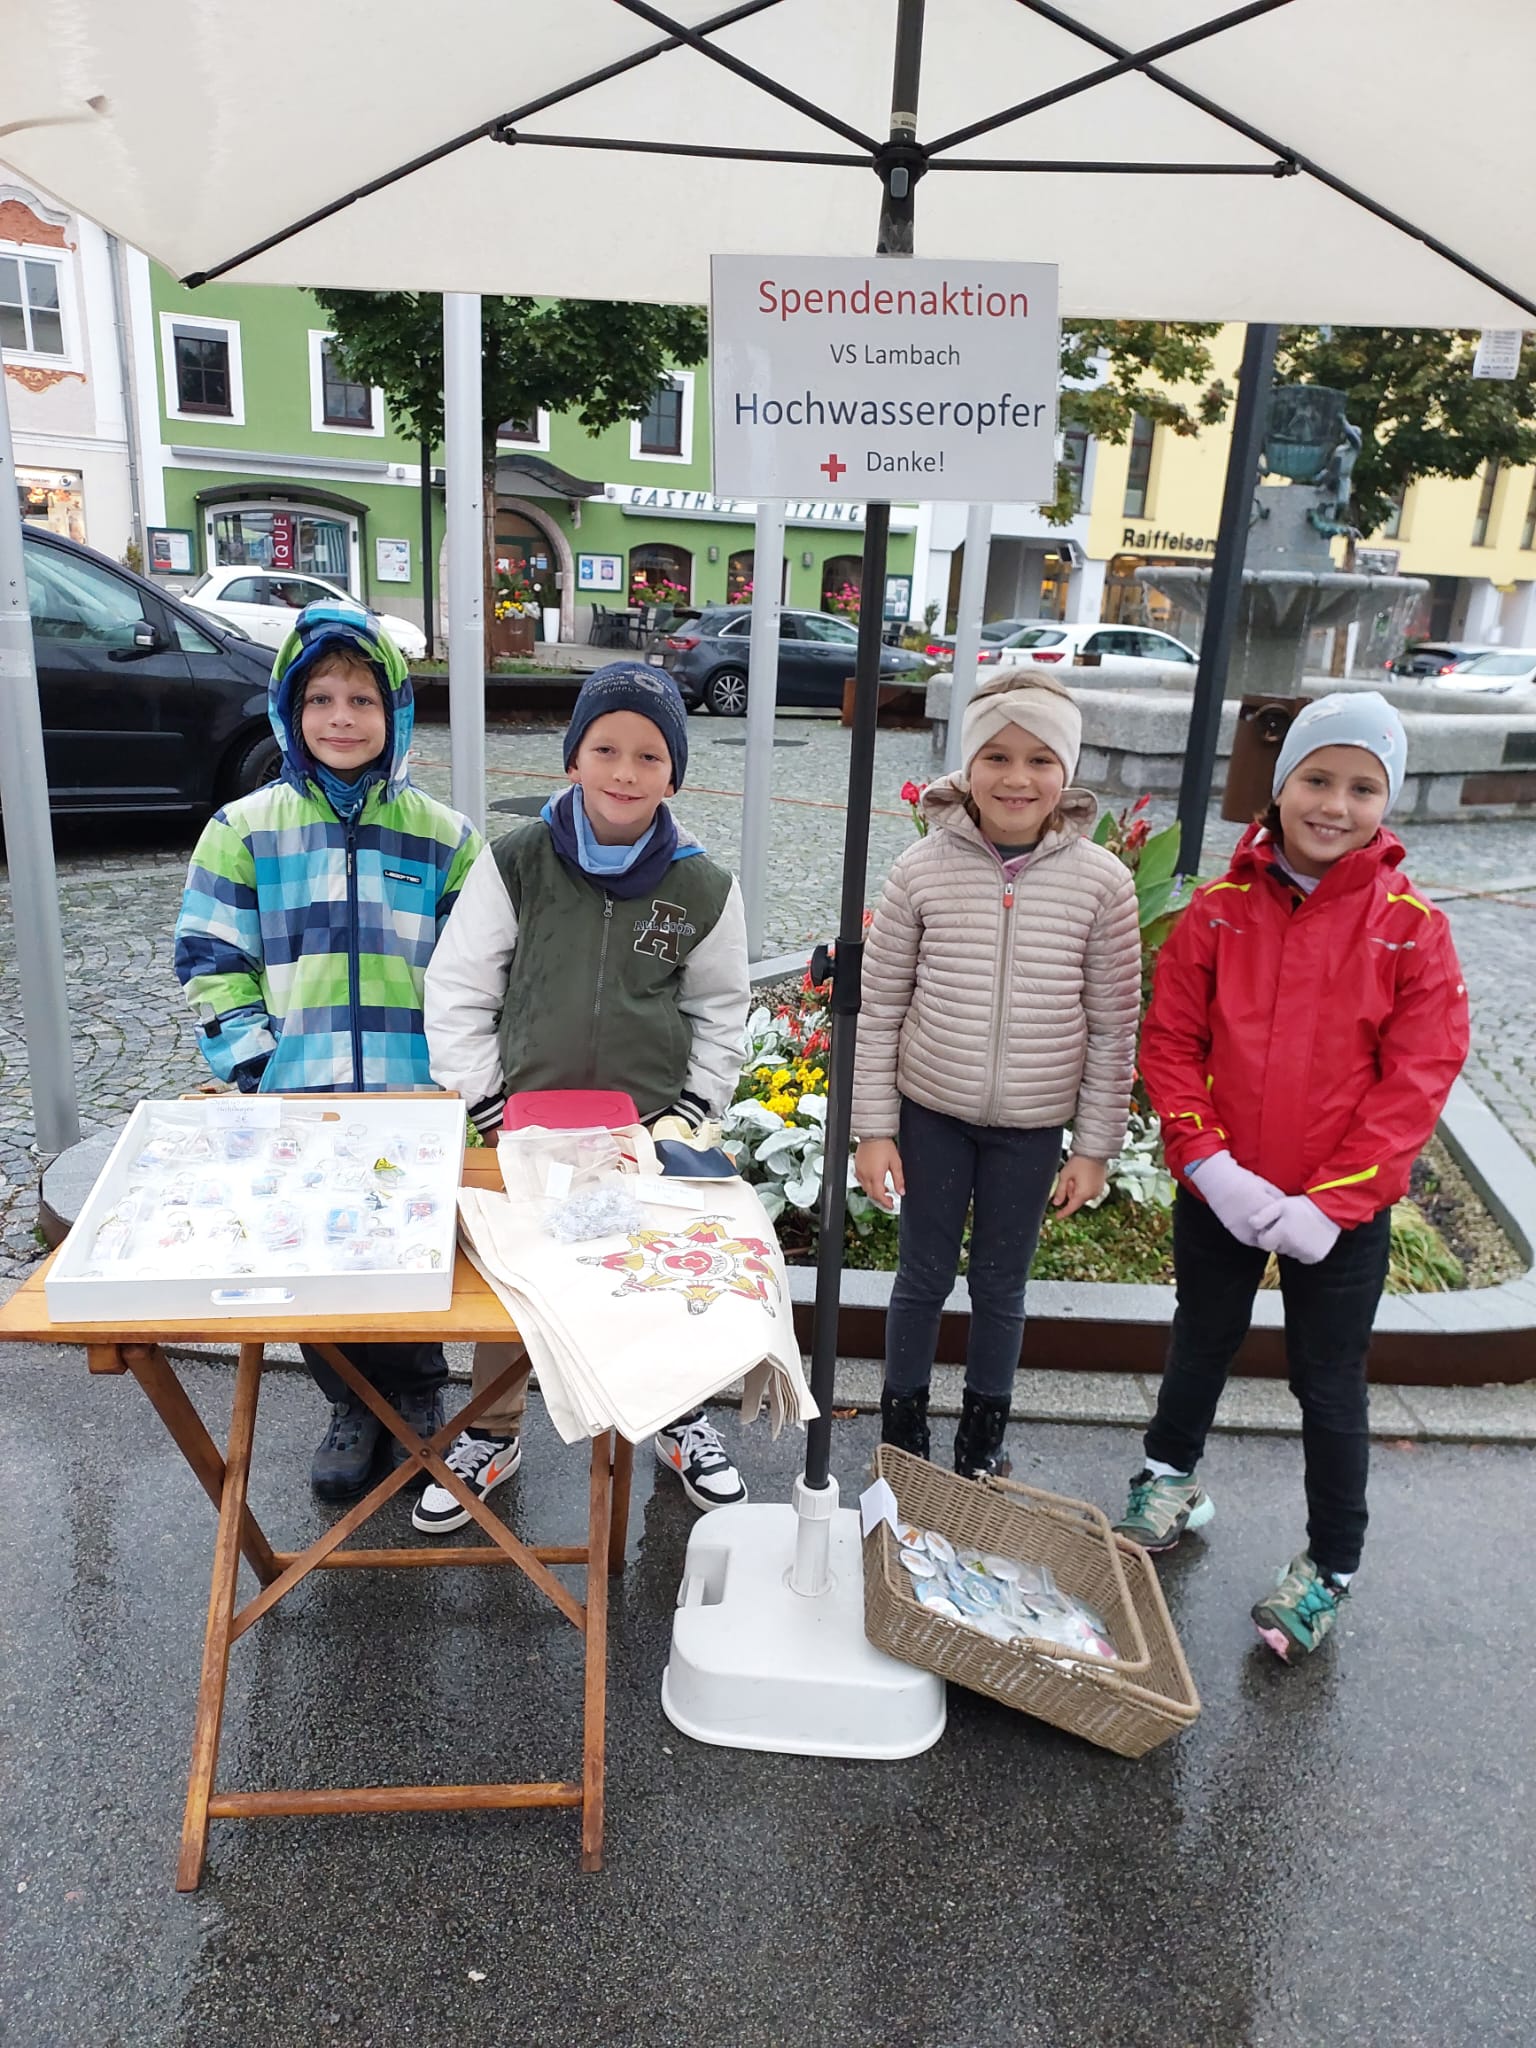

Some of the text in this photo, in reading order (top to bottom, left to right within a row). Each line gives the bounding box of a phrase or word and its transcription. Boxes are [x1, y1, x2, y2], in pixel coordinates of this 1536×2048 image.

[758, 279, 1029, 321] Spendenaktion
[830, 344, 960, 366] VS Lambach
[735, 391, 1046, 434] Hochwasseropfer
[866, 451, 945, 472] Danke!
[273, 517, 289, 567] IQUE
